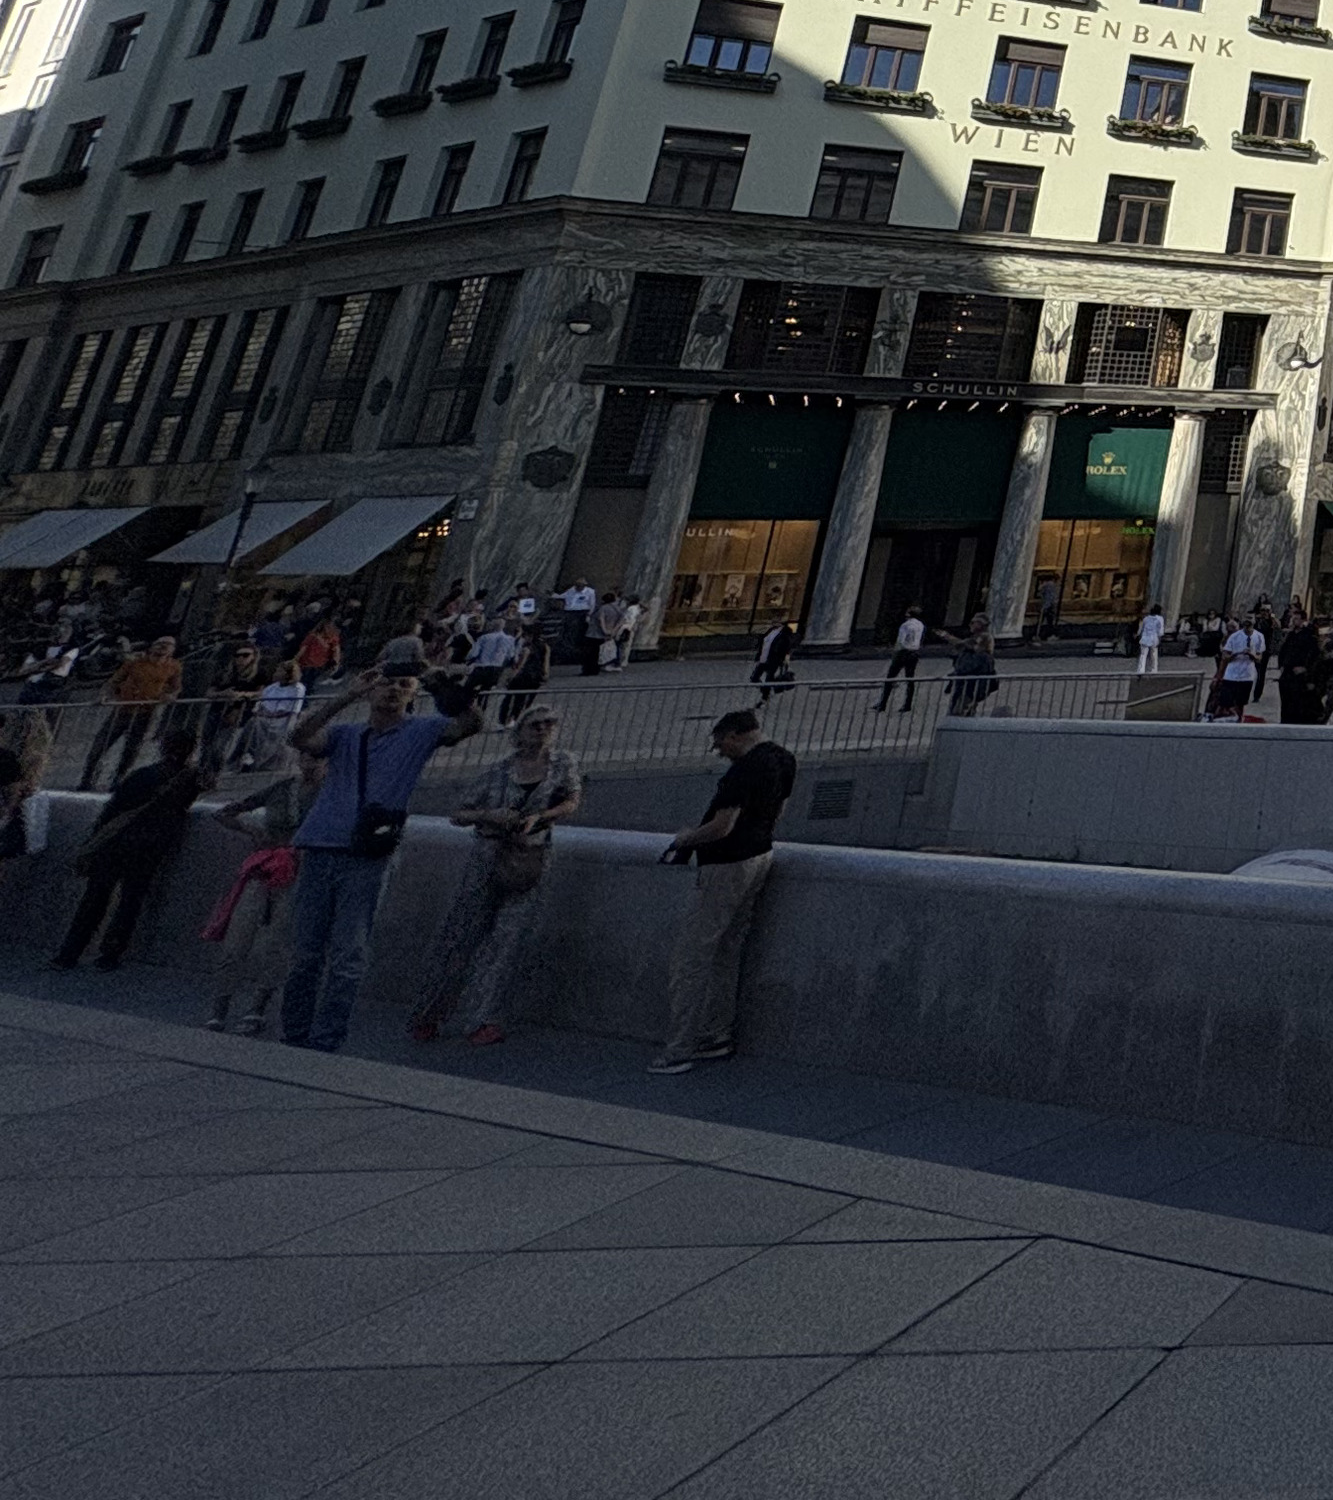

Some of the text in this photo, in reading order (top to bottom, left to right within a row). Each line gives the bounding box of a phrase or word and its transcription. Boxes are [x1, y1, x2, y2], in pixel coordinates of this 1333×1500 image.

[949, 121, 1078, 158] WIEN
[911, 381, 1018, 397] SCHULLIN
[1086, 465, 1128, 476] ROLEX
